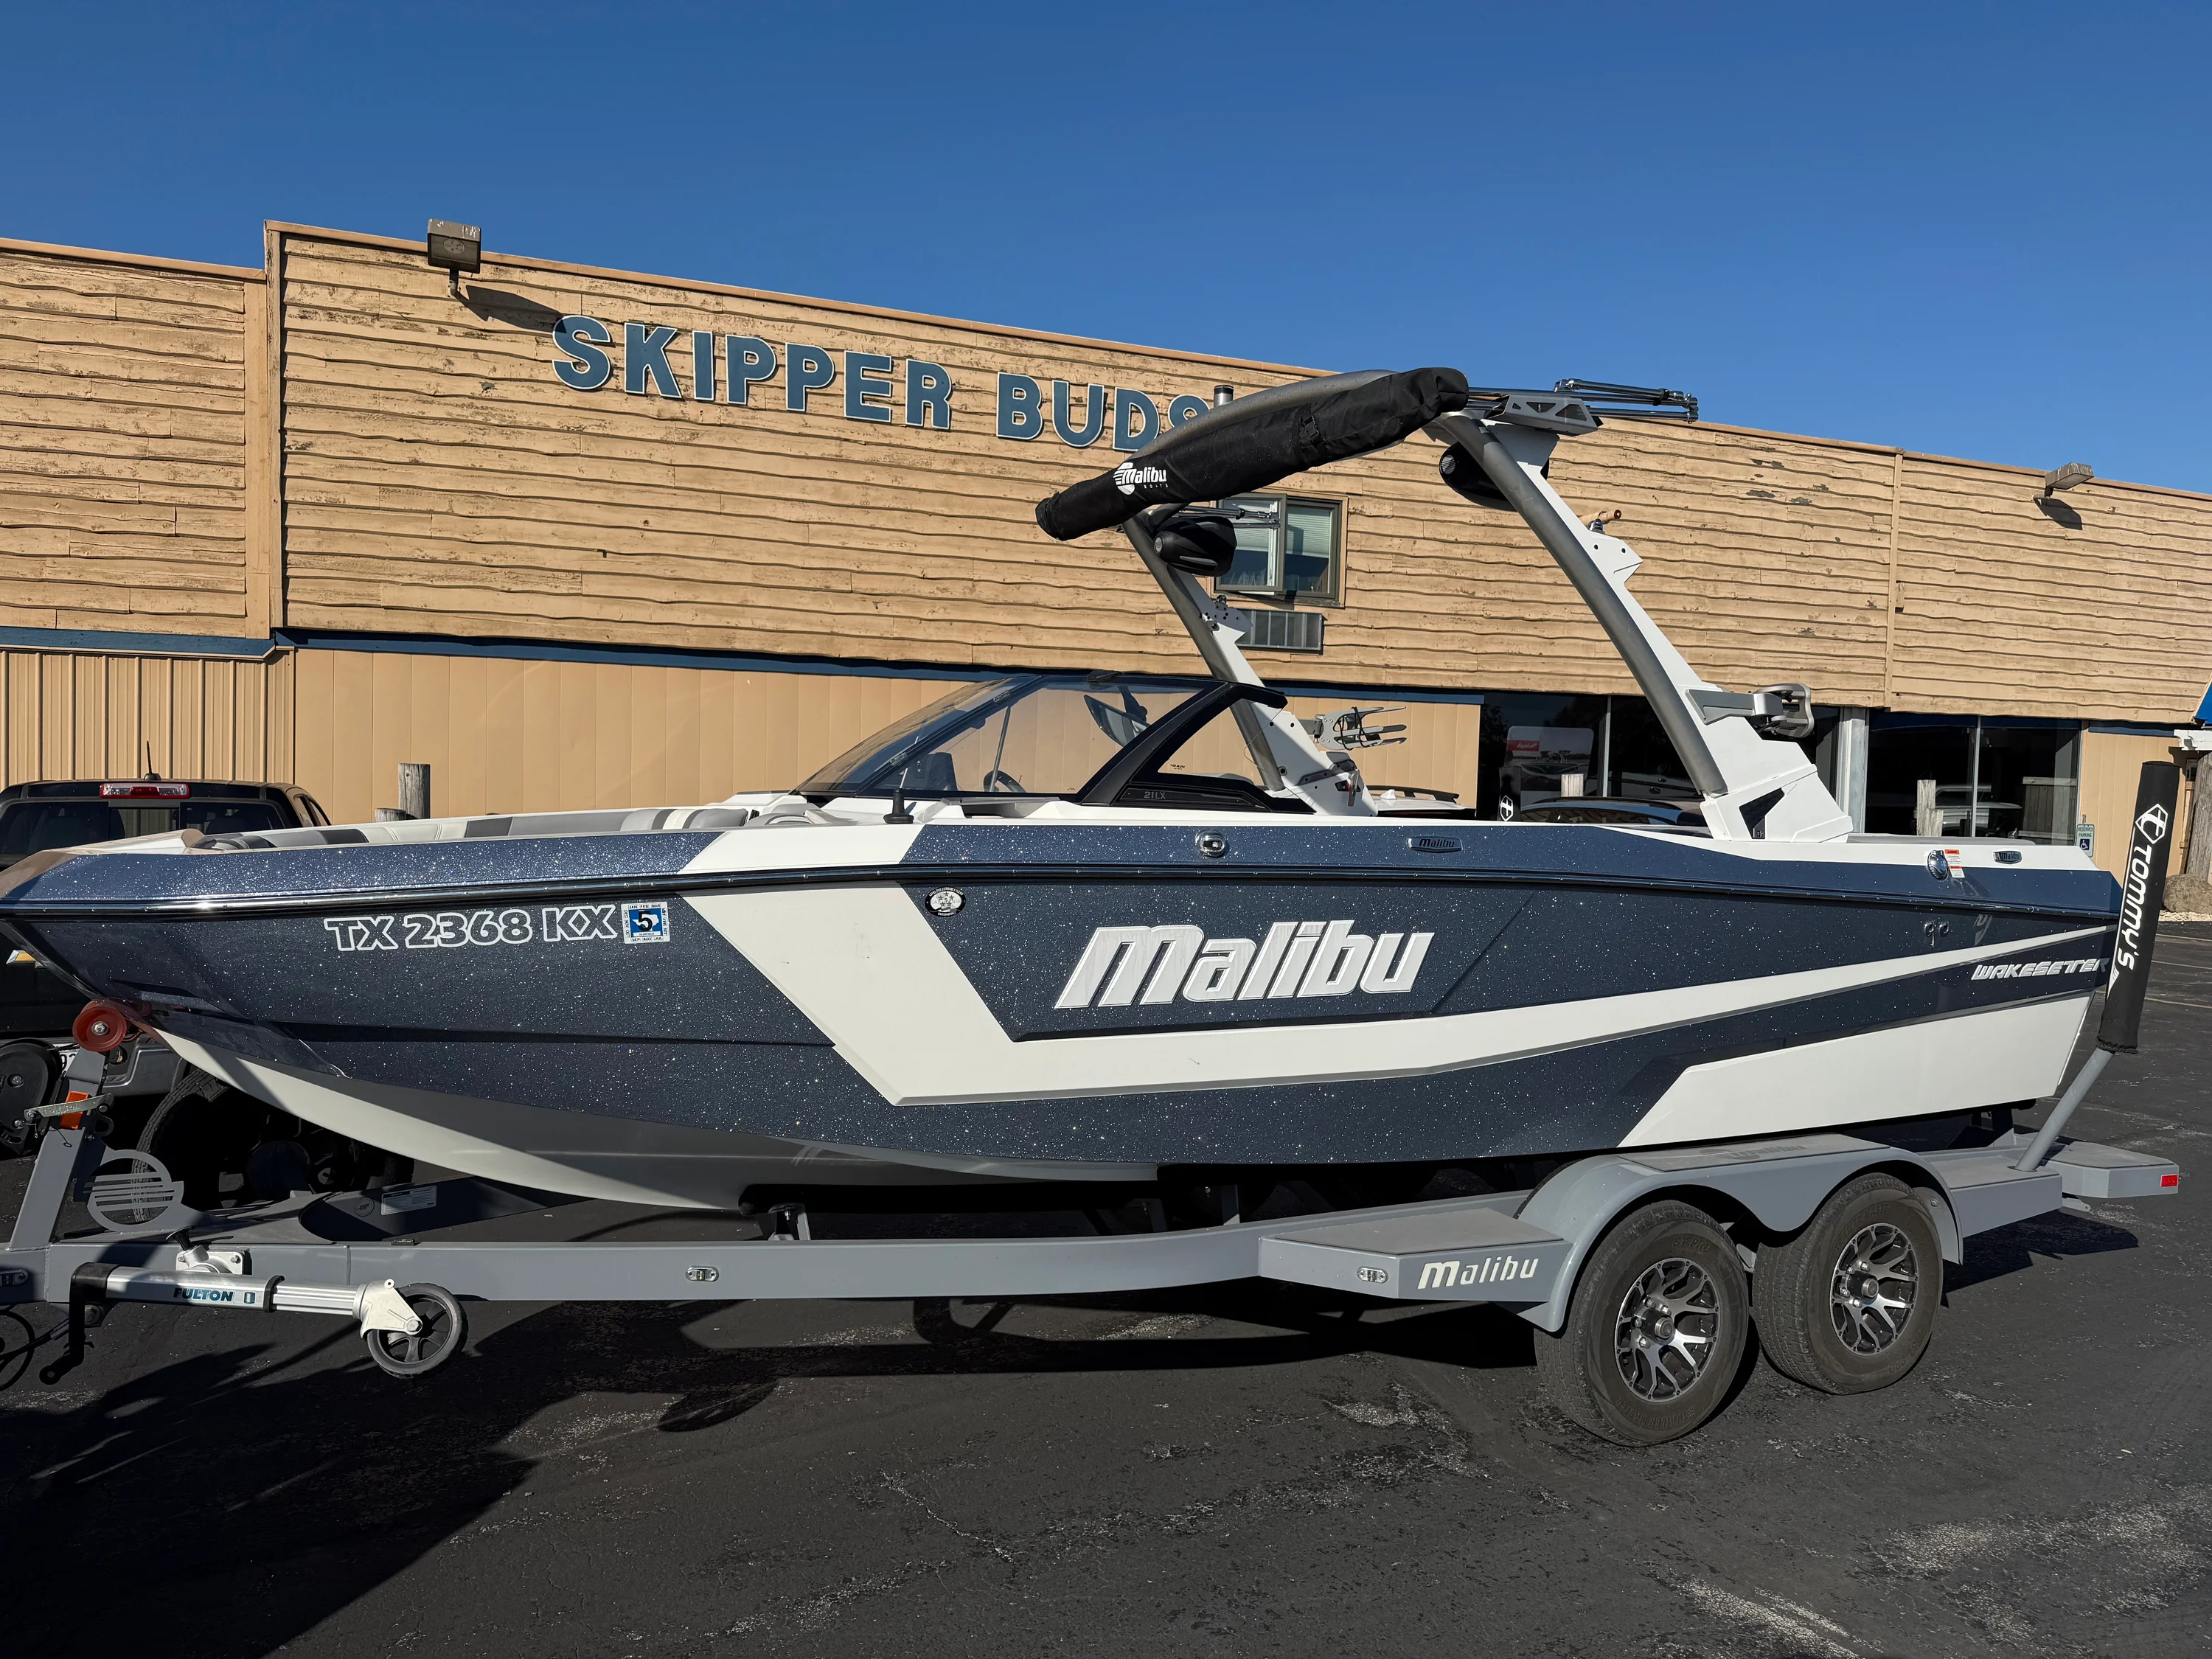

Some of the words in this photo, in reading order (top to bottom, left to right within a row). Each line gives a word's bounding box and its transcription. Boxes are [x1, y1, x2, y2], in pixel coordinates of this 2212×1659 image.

[552, 315, 952, 431] SKIPPER
[1121, 466, 1167, 484] Malibu
[1144, 791, 1166, 800] 21LX
[1419, 838, 1455, 848] Malibu
[324, 916, 398, 951] TX
[403, 909, 533, 949] 2368
[542, 904, 618, 942] KX
[639, 911, 653, 931] 5
[1054, 920, 1435, 1009] Malibu
[1971, 958, 2110, 981] WAKESETTER
[1417, 1255, 1540, 1290] Malibu
[173, 1287, 234, 1302] FULTON
